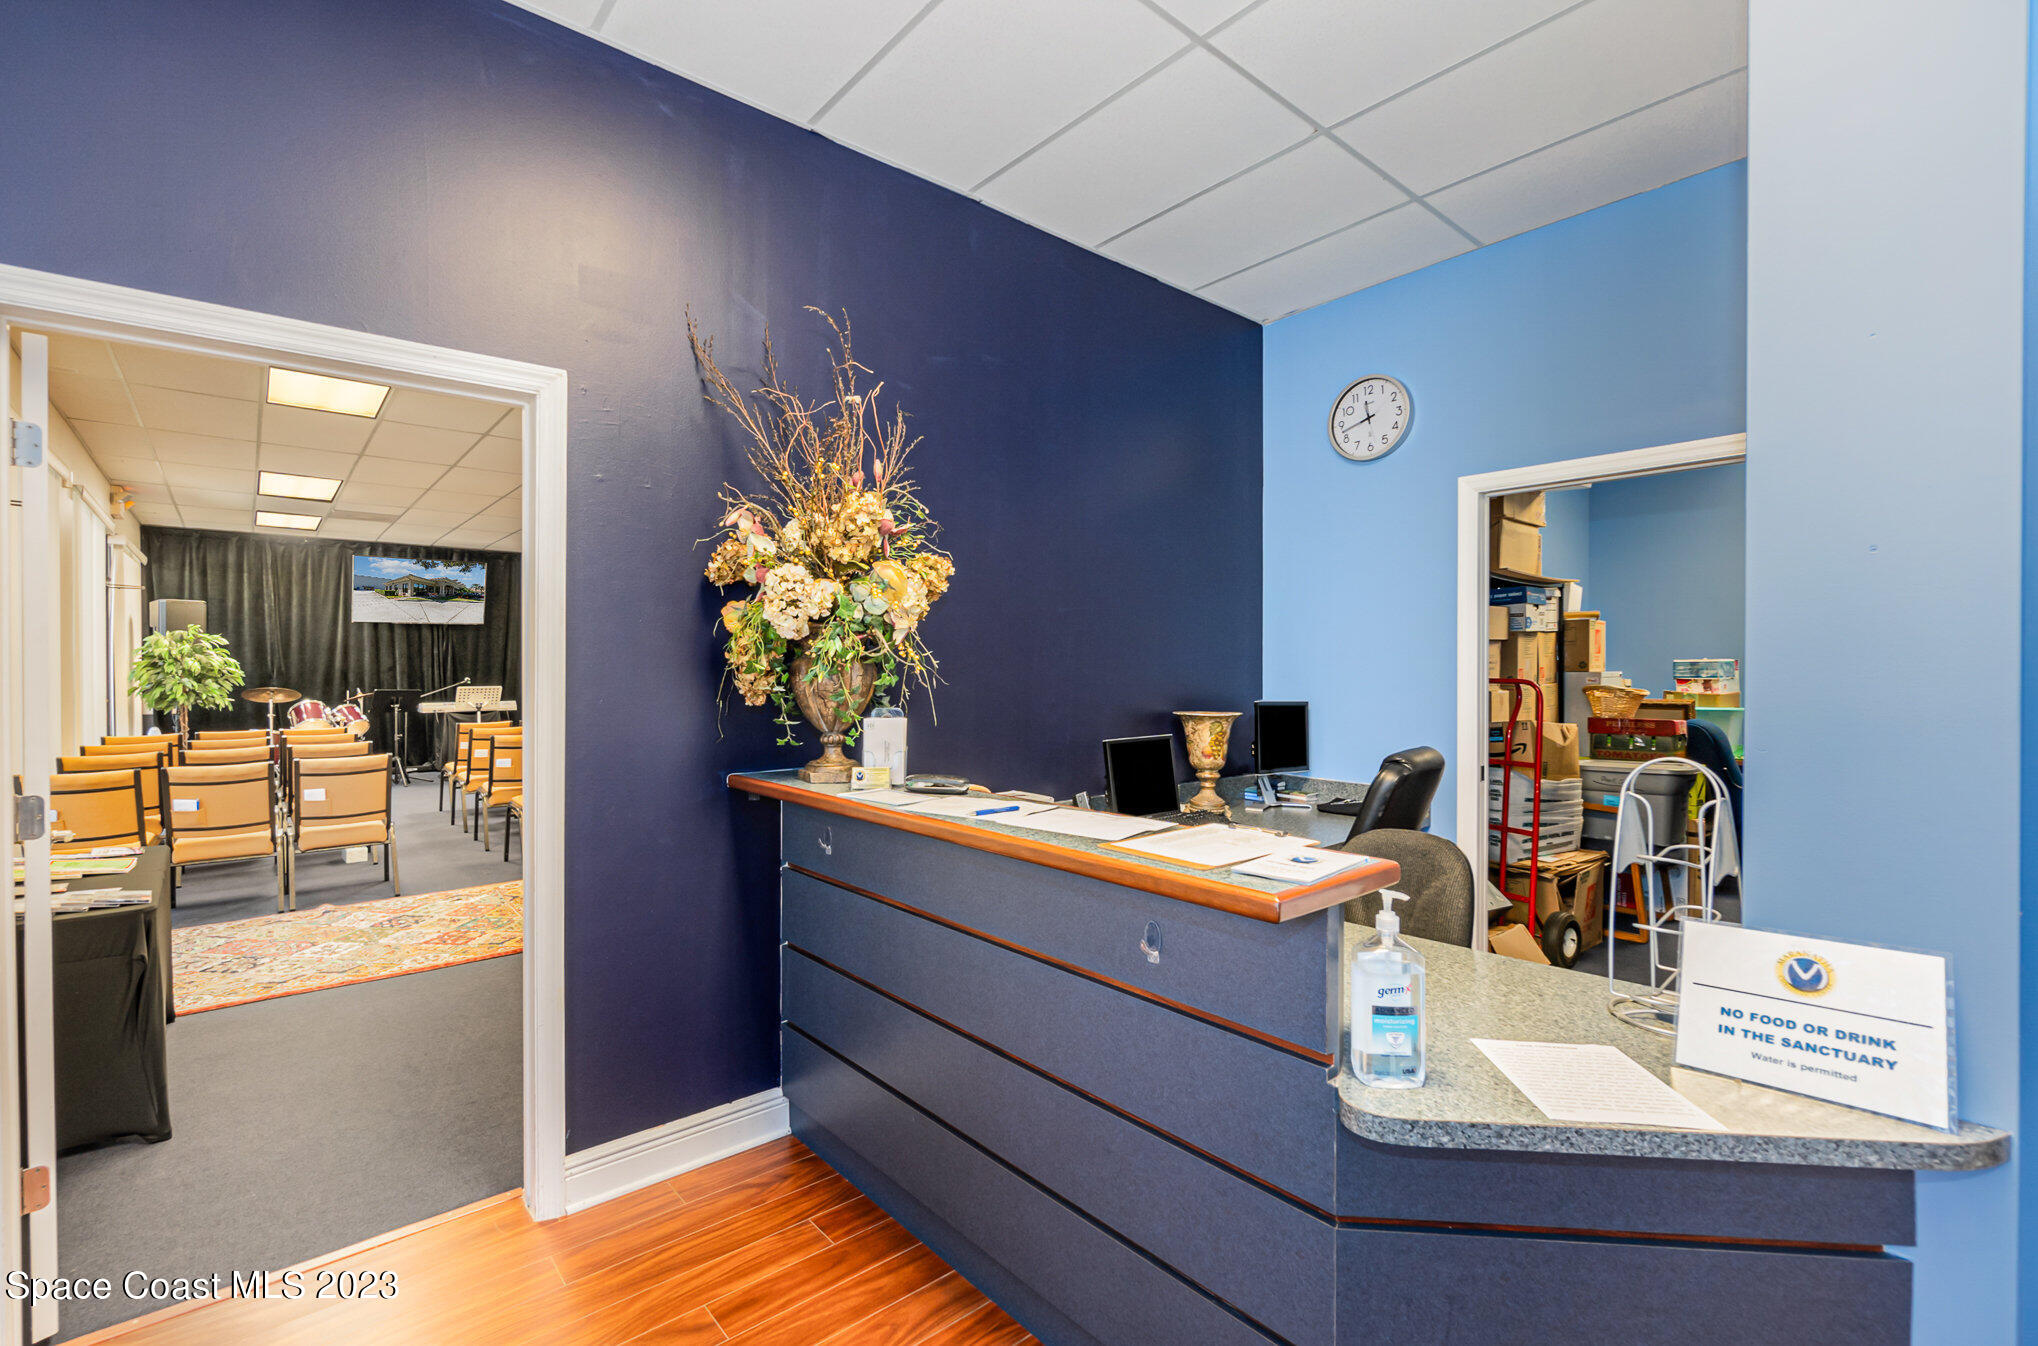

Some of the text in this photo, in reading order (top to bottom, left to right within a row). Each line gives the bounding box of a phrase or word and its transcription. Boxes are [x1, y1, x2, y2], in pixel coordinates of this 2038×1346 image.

[1364, 385, 1374, 395] 12
[1381, 385, 1384, 394] 1
[1352, 394, 1359, 403] 11
[1391, 392, 1397, 402] 2
[1342, 406, 1354, 417] 10
[1396, 406, 1402, 416] 3
[1338, 421, 1345, 429] 9
[1392, 421, 1399, 429] 4
[1343, 434, 1349, 443] 8
[1382, 434, 1388, 444] 5
[1354, 441, 1360, 450] 7
[1367, 443, 1374, 451] 6
[1720, 1006, 1897, 1051] NO FOOD OR DRINK
[1718, 1024, 1898, 1071] IN THE SANCTUARY
[1751, 1051, 1858, 1083] Water is permitted
